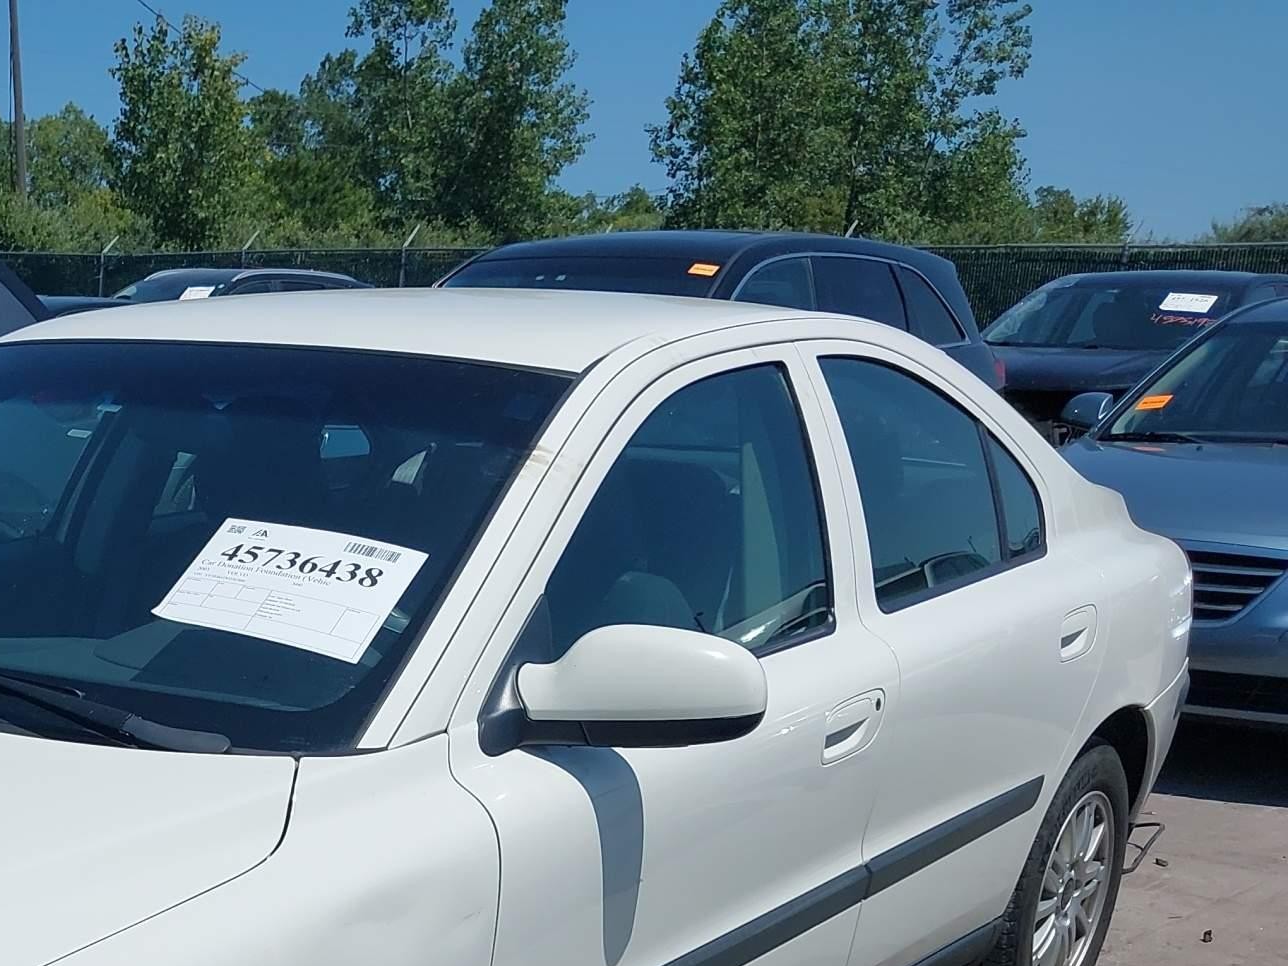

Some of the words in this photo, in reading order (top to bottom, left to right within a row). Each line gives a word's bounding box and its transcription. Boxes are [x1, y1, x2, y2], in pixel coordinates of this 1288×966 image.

[201, 558, 217, 567] Car
[217, 560, 254, 573] Donation
[255, 566, 302, 581] Foundation
[220, 542, 385, 588] 45736438
